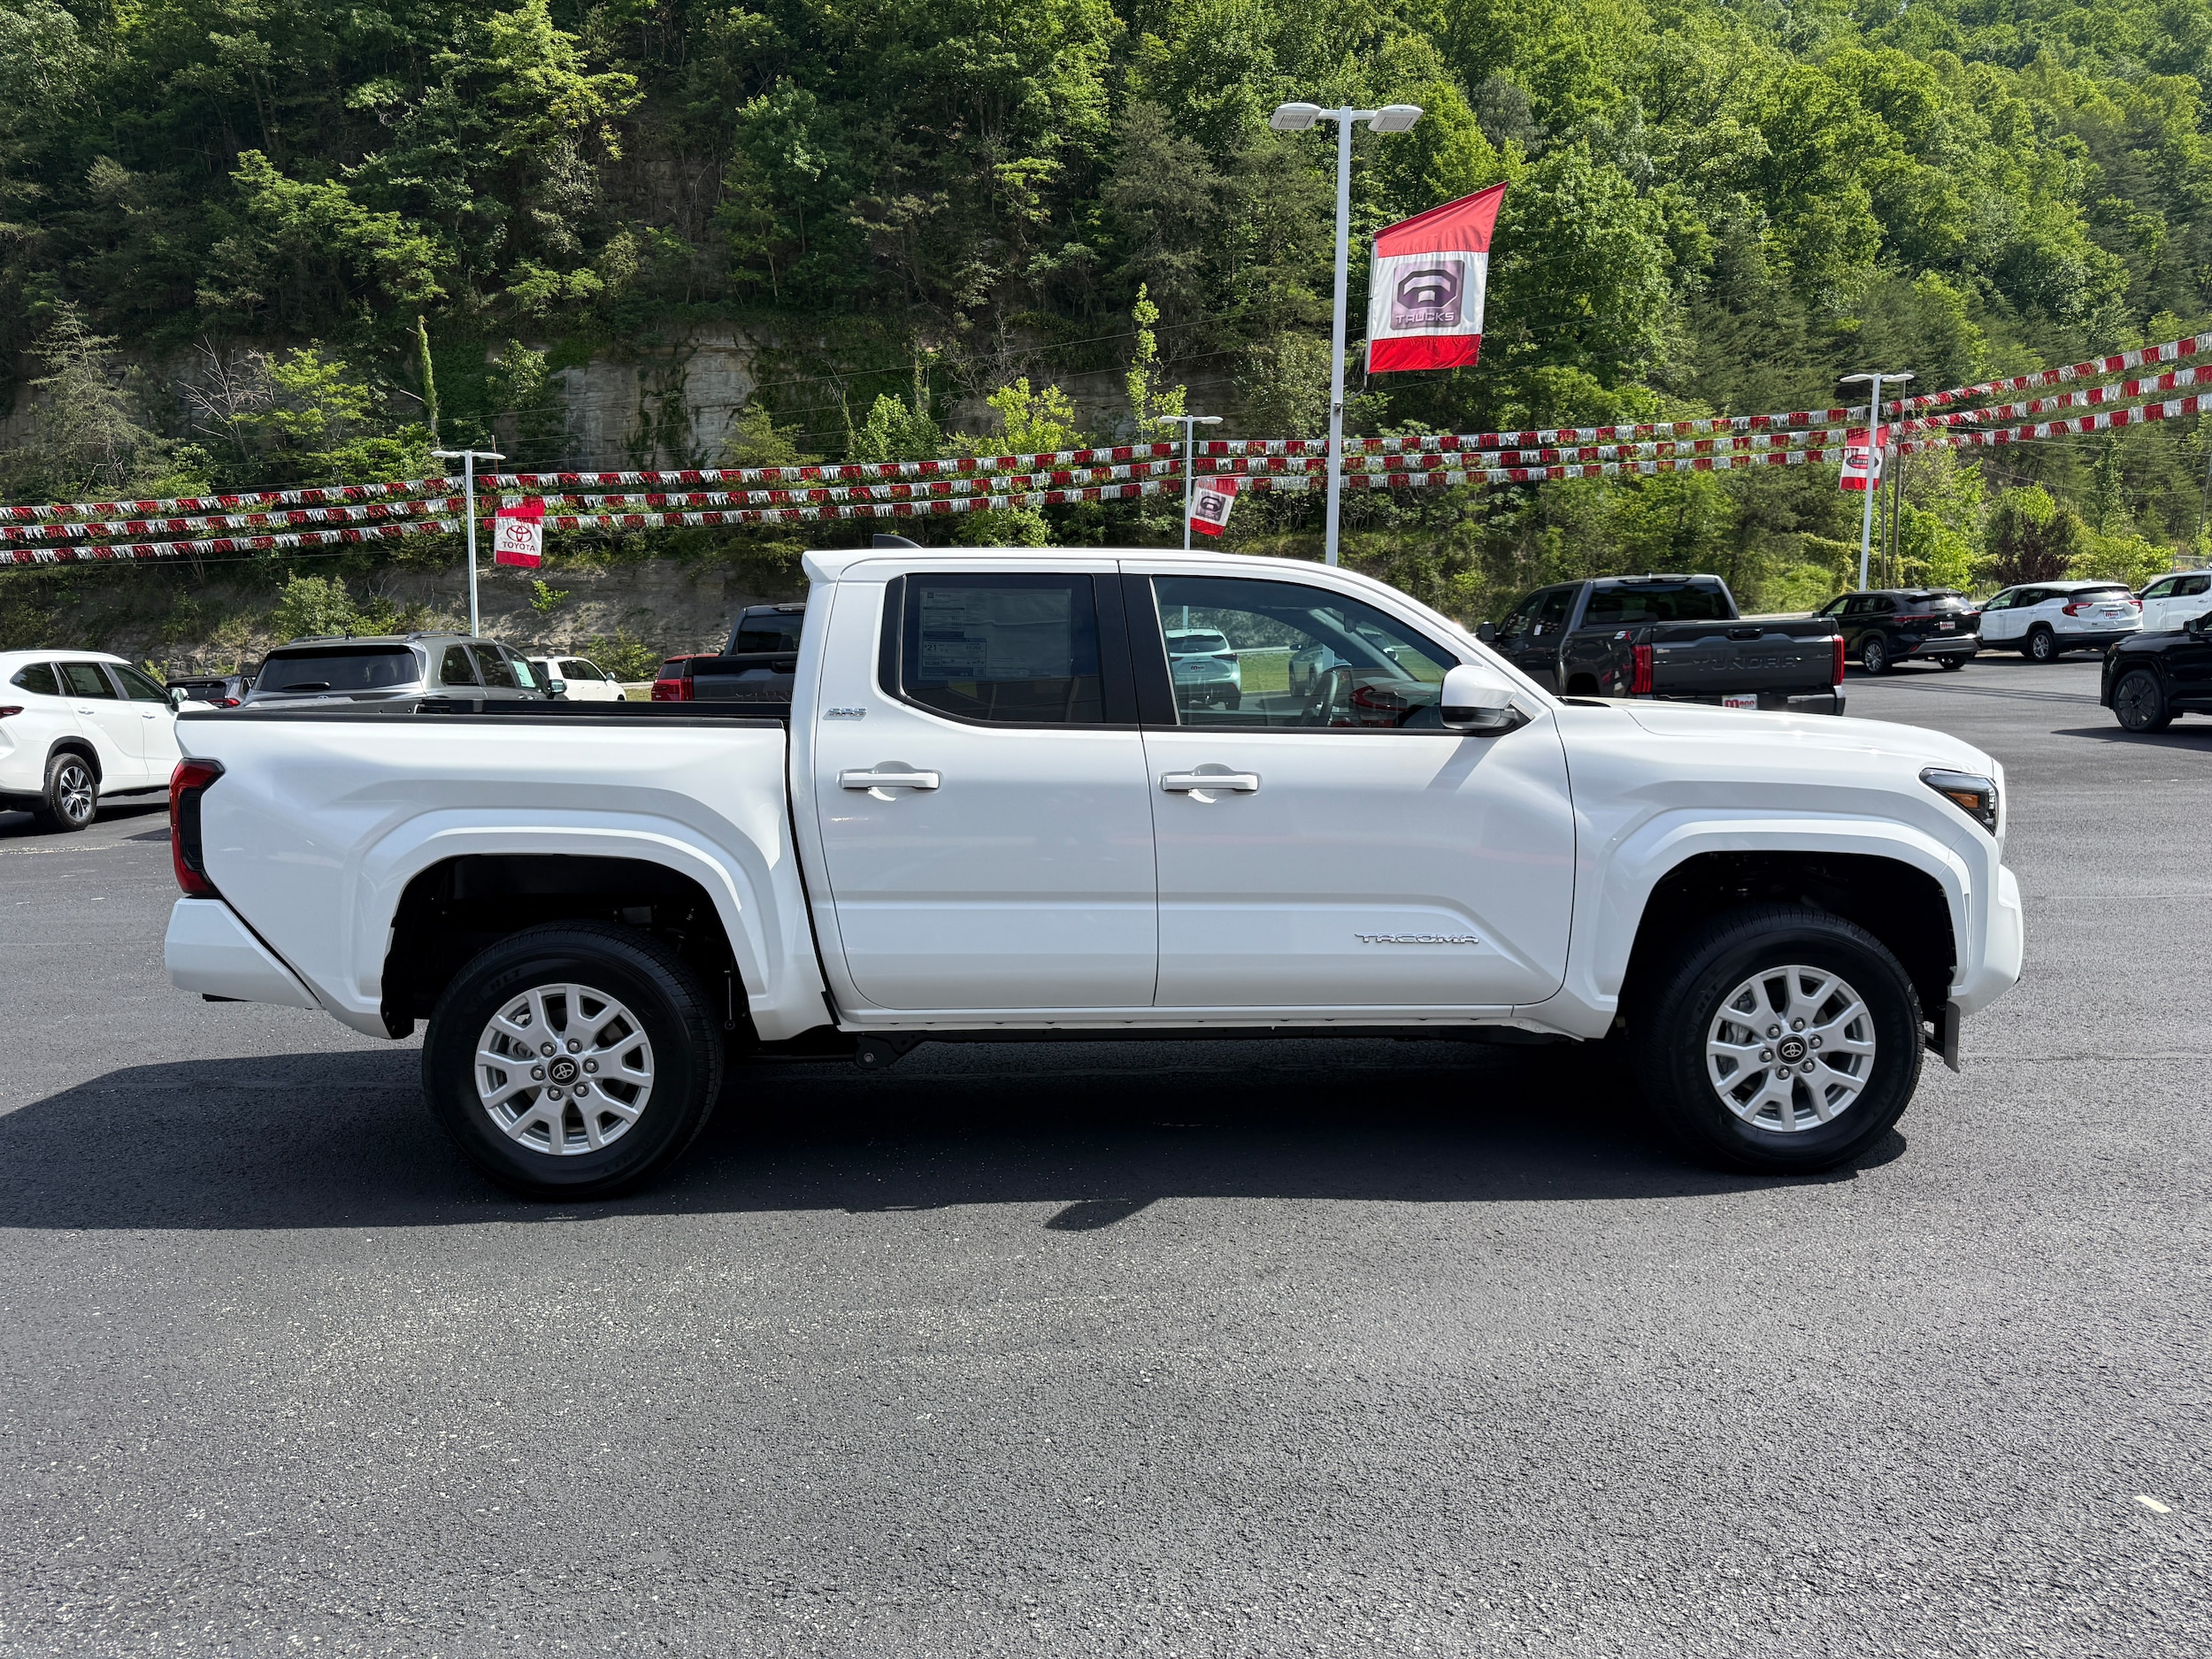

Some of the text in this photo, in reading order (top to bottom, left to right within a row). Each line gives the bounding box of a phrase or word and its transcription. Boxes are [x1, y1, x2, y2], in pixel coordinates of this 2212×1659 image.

[1395, 311, 1455, 324] TRUCKS
[503, 541, 535, 551] TOYOTA
[1693, 657, 1798, 672] TUNDRA
[1355, 933, 1479, 944] TACOMA
